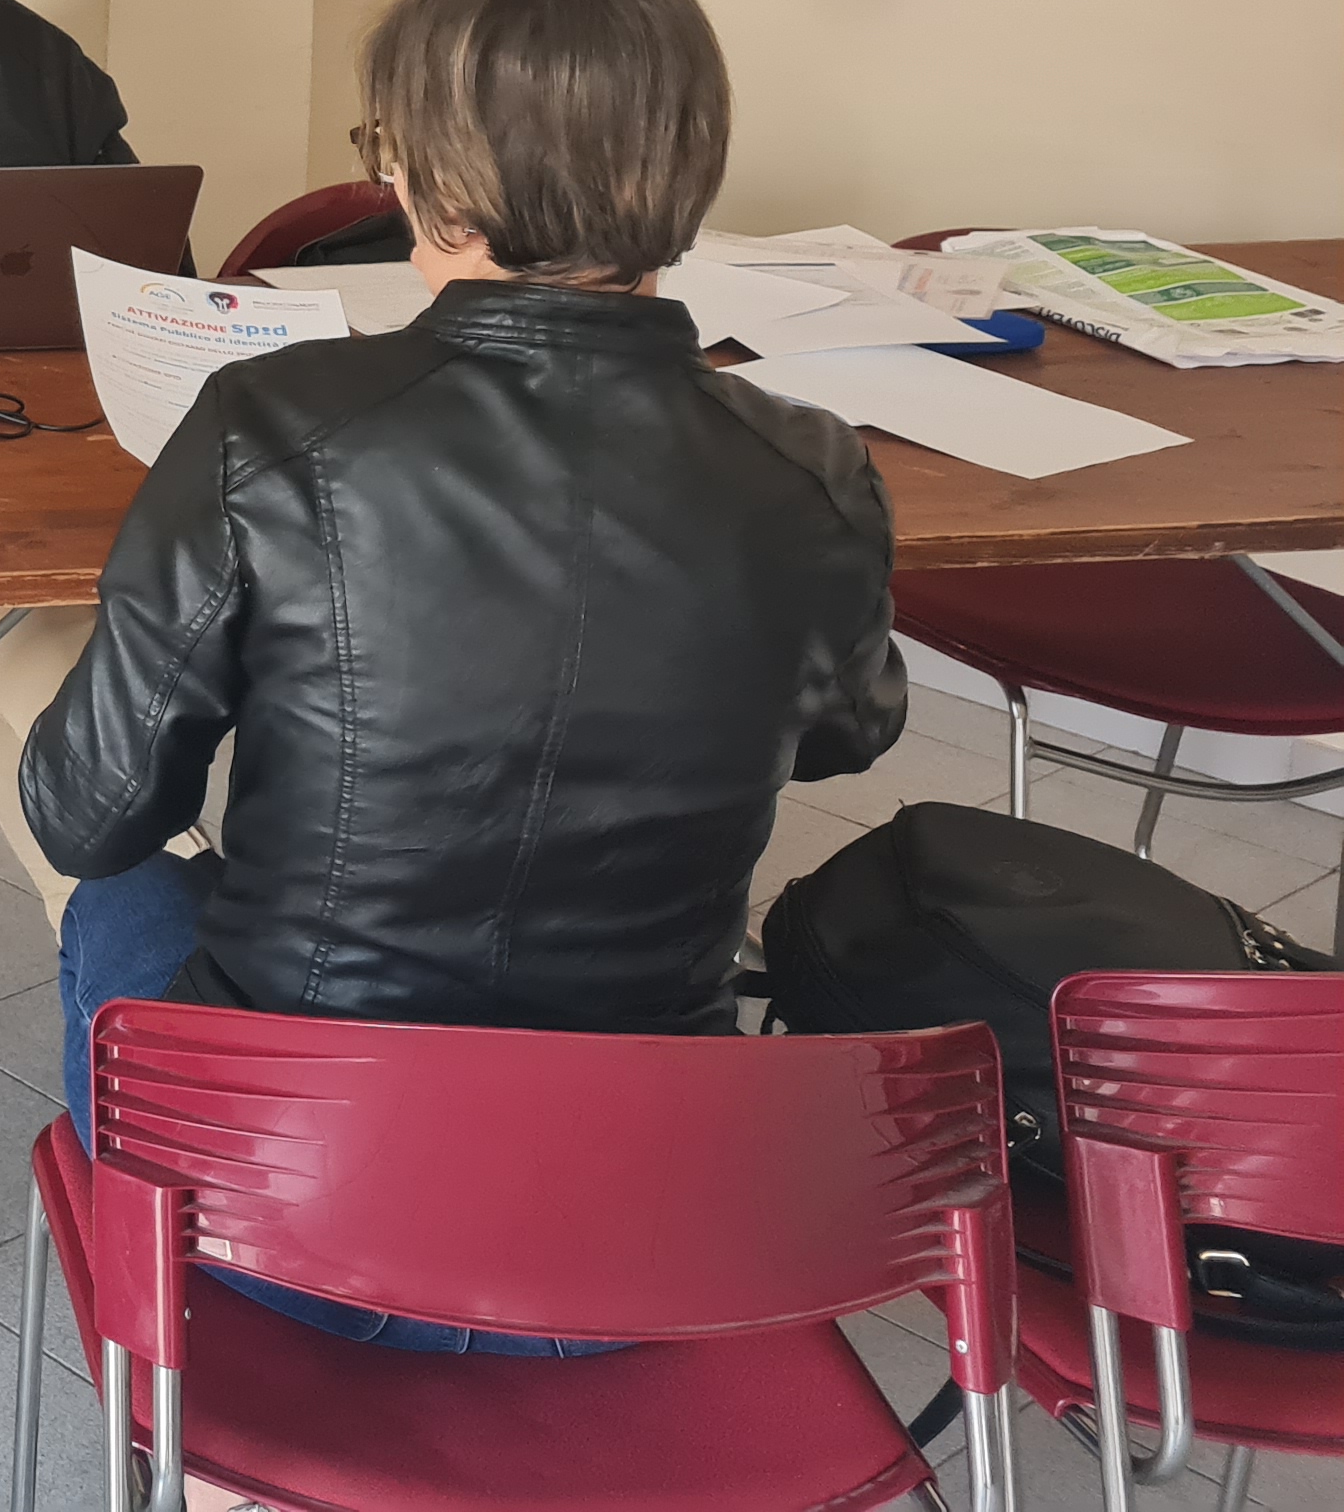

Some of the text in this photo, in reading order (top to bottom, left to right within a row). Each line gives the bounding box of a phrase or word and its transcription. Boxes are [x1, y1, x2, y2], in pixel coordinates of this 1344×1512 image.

[111, 311, 157, 331] Sistema
[160, 326, 212, 342] Pubblico
[127, 306, 227, 334] ATTIVAZIONE
